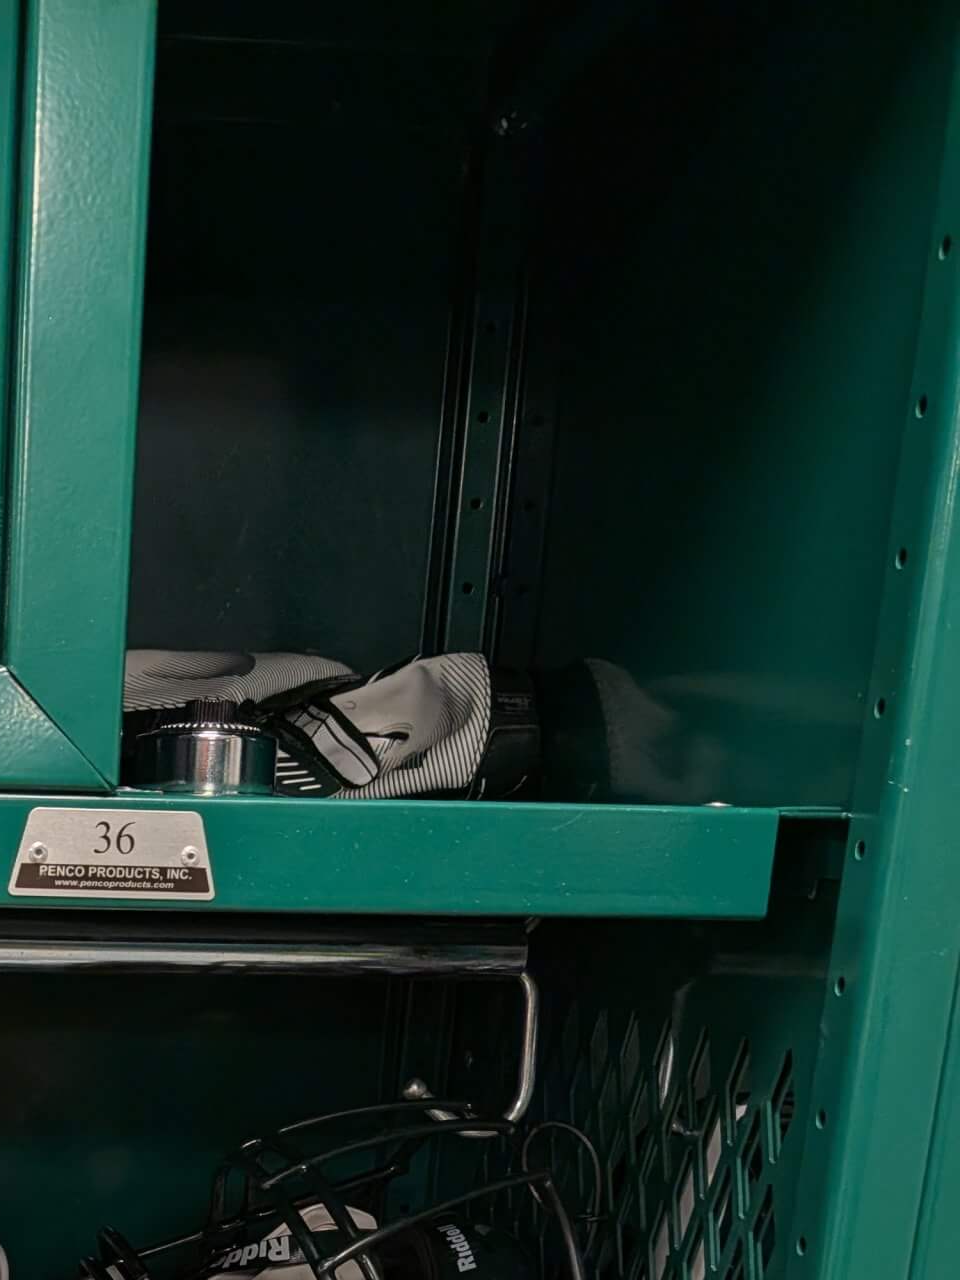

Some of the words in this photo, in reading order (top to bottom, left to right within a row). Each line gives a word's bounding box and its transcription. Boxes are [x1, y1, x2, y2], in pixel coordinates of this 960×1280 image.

[93, 821, 136, 854] 36
[40, 865, 84, 878] PENCO
[88, 867, 163, 880] PRODUCTS,
[167, 869, 192, 880] INC.
[54, 878, 175, 889] www.pencoproducts.com
[436, 1224, 477, 1272] Riddell
